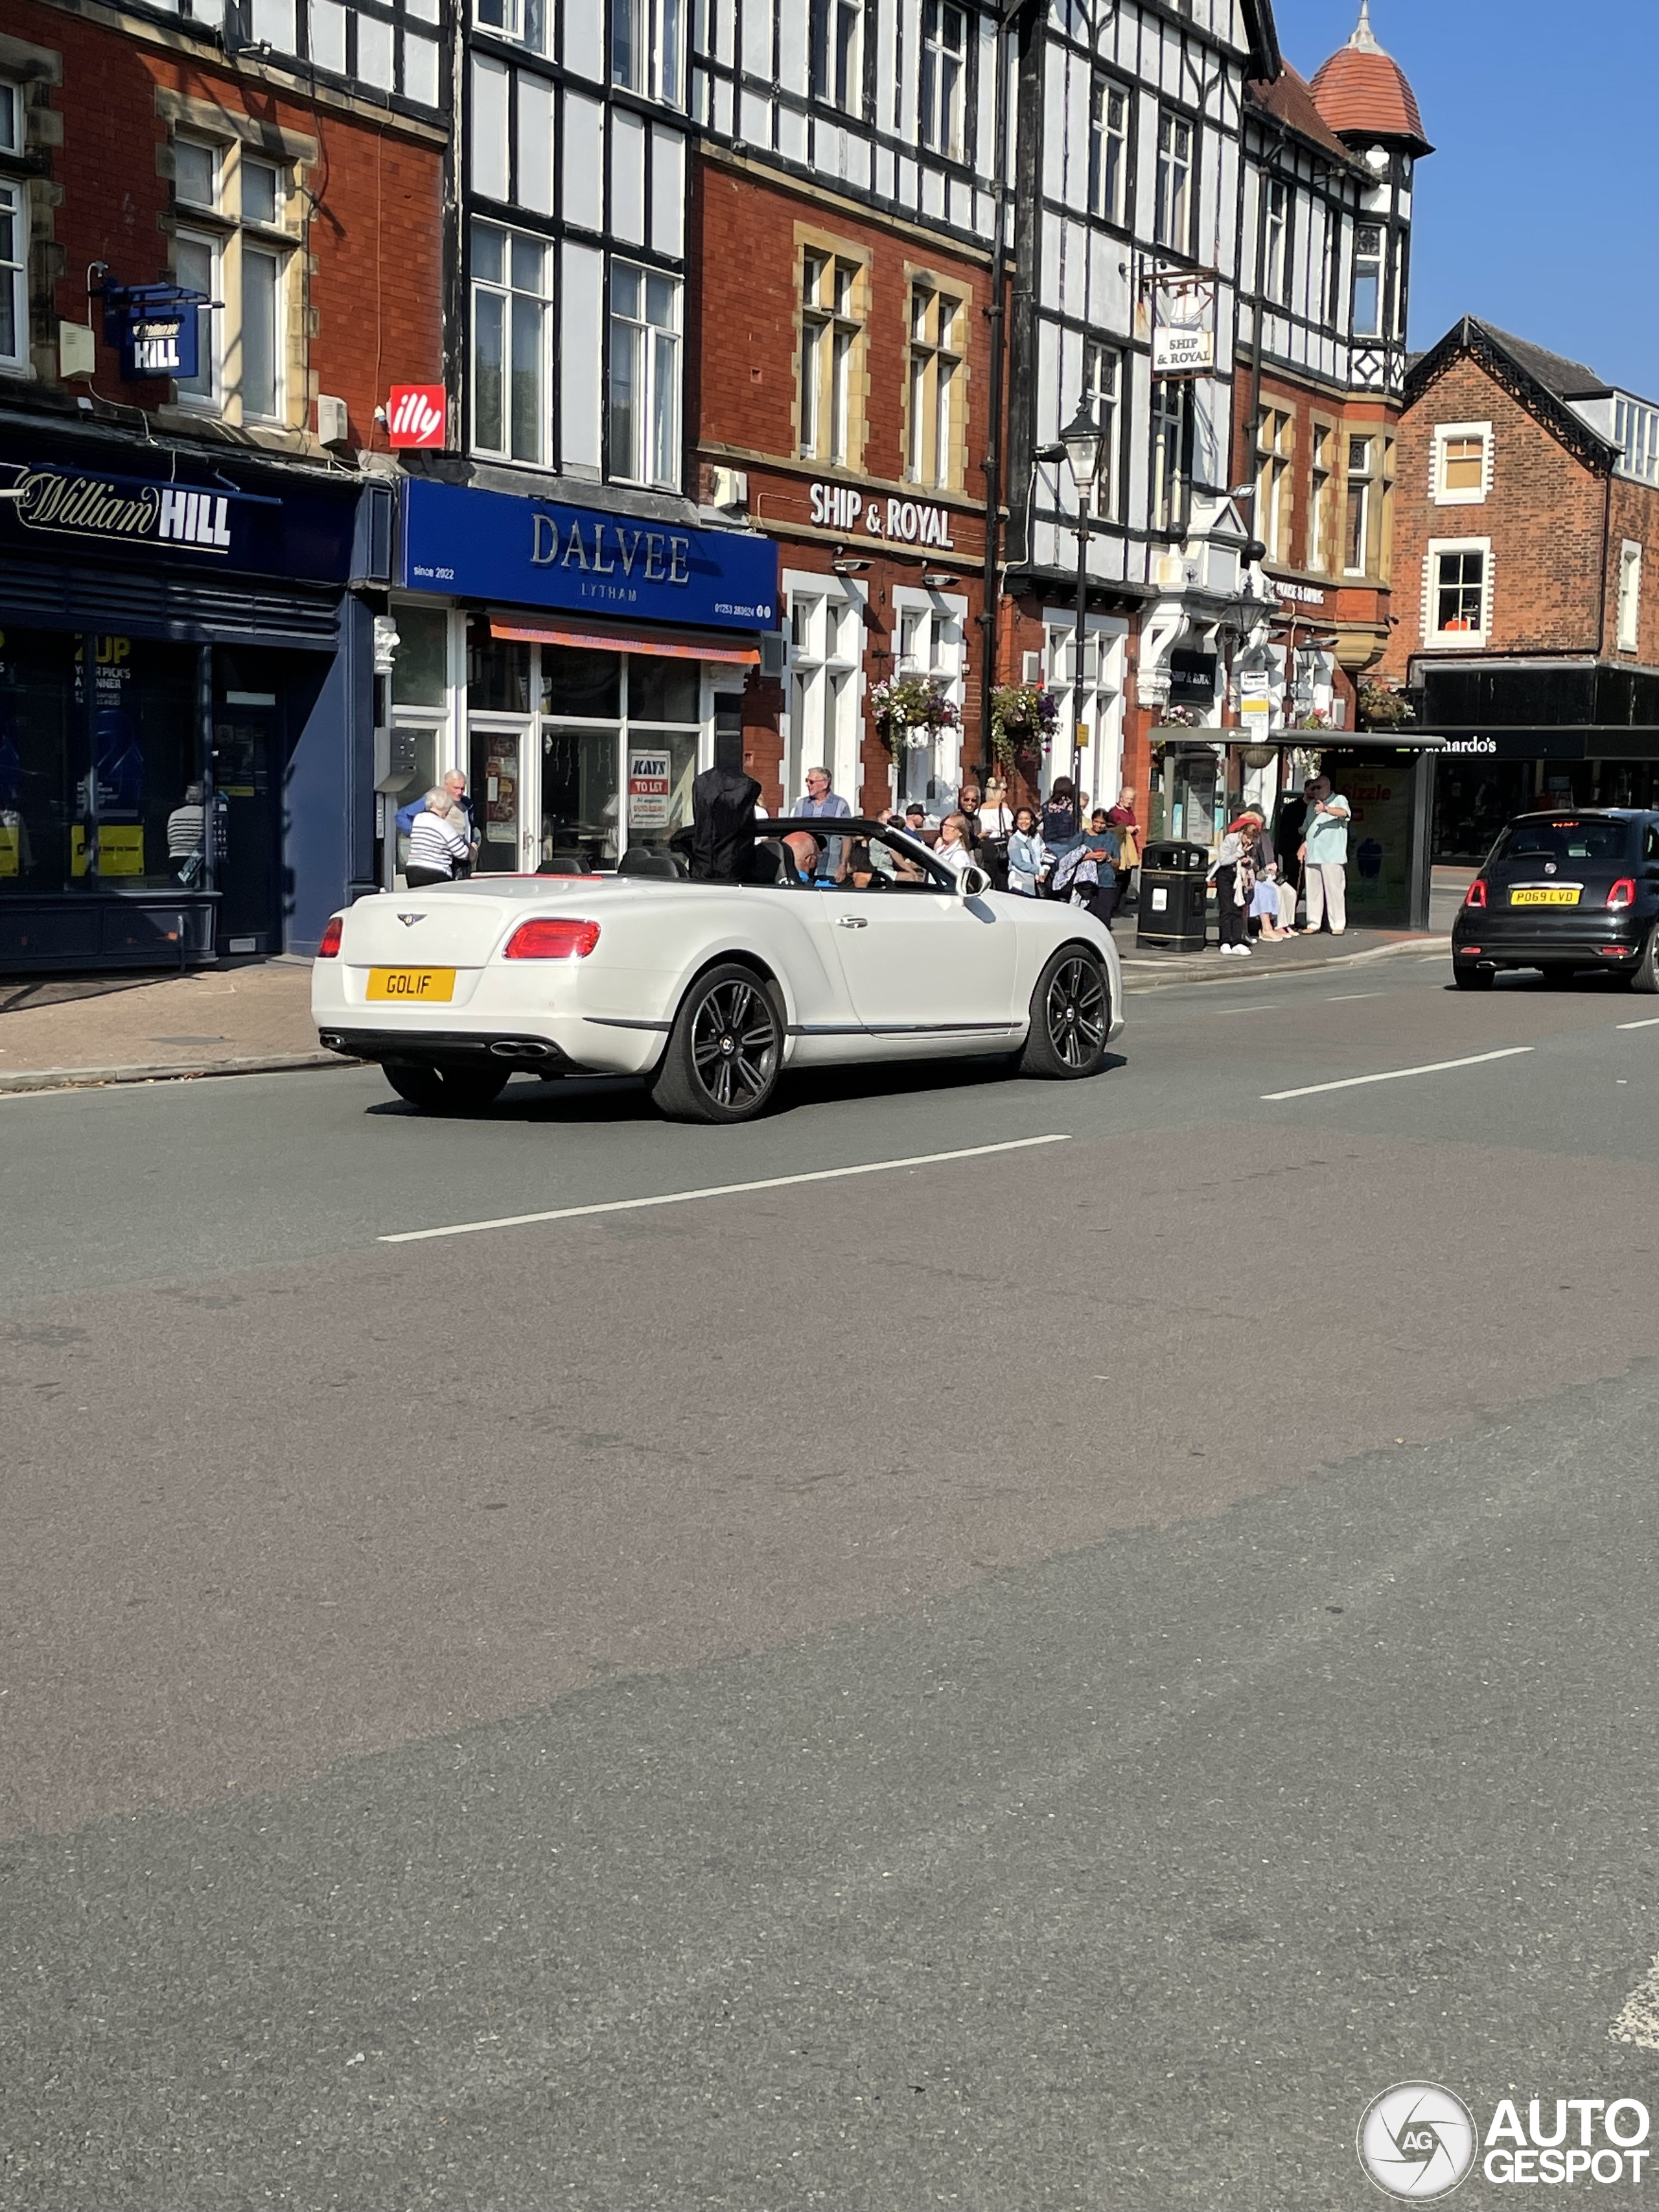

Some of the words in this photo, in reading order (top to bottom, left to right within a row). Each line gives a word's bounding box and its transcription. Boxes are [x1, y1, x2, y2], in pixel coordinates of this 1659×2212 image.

[1169, 338, 1198, 350] SHIP
[134, 340, 180, 368] HILL
[1157, 355, 1168, 364] &
[1170, 351, 1211, 364] ROYAL
[393, 393, 441, 443] illy
[15, 470, 160, 533] William
[159, 489, 231, 546] HILL
[810, 483, 862, 528] SHIP
[866, 504, 883, 533] &
[887, 498, 954, 548] ROYAL
[529, 513, 690, 583] DALVEE
[581, 583, 637, 601] LYTHAM
[632, 760, 666, 774] KAYS
[634, 781, 647, 792] TO
[649, 781, 663, 793] LET
[1343, 783, 1392, 800] Sizzle
[1549, 892, 1573, 902] LVD
